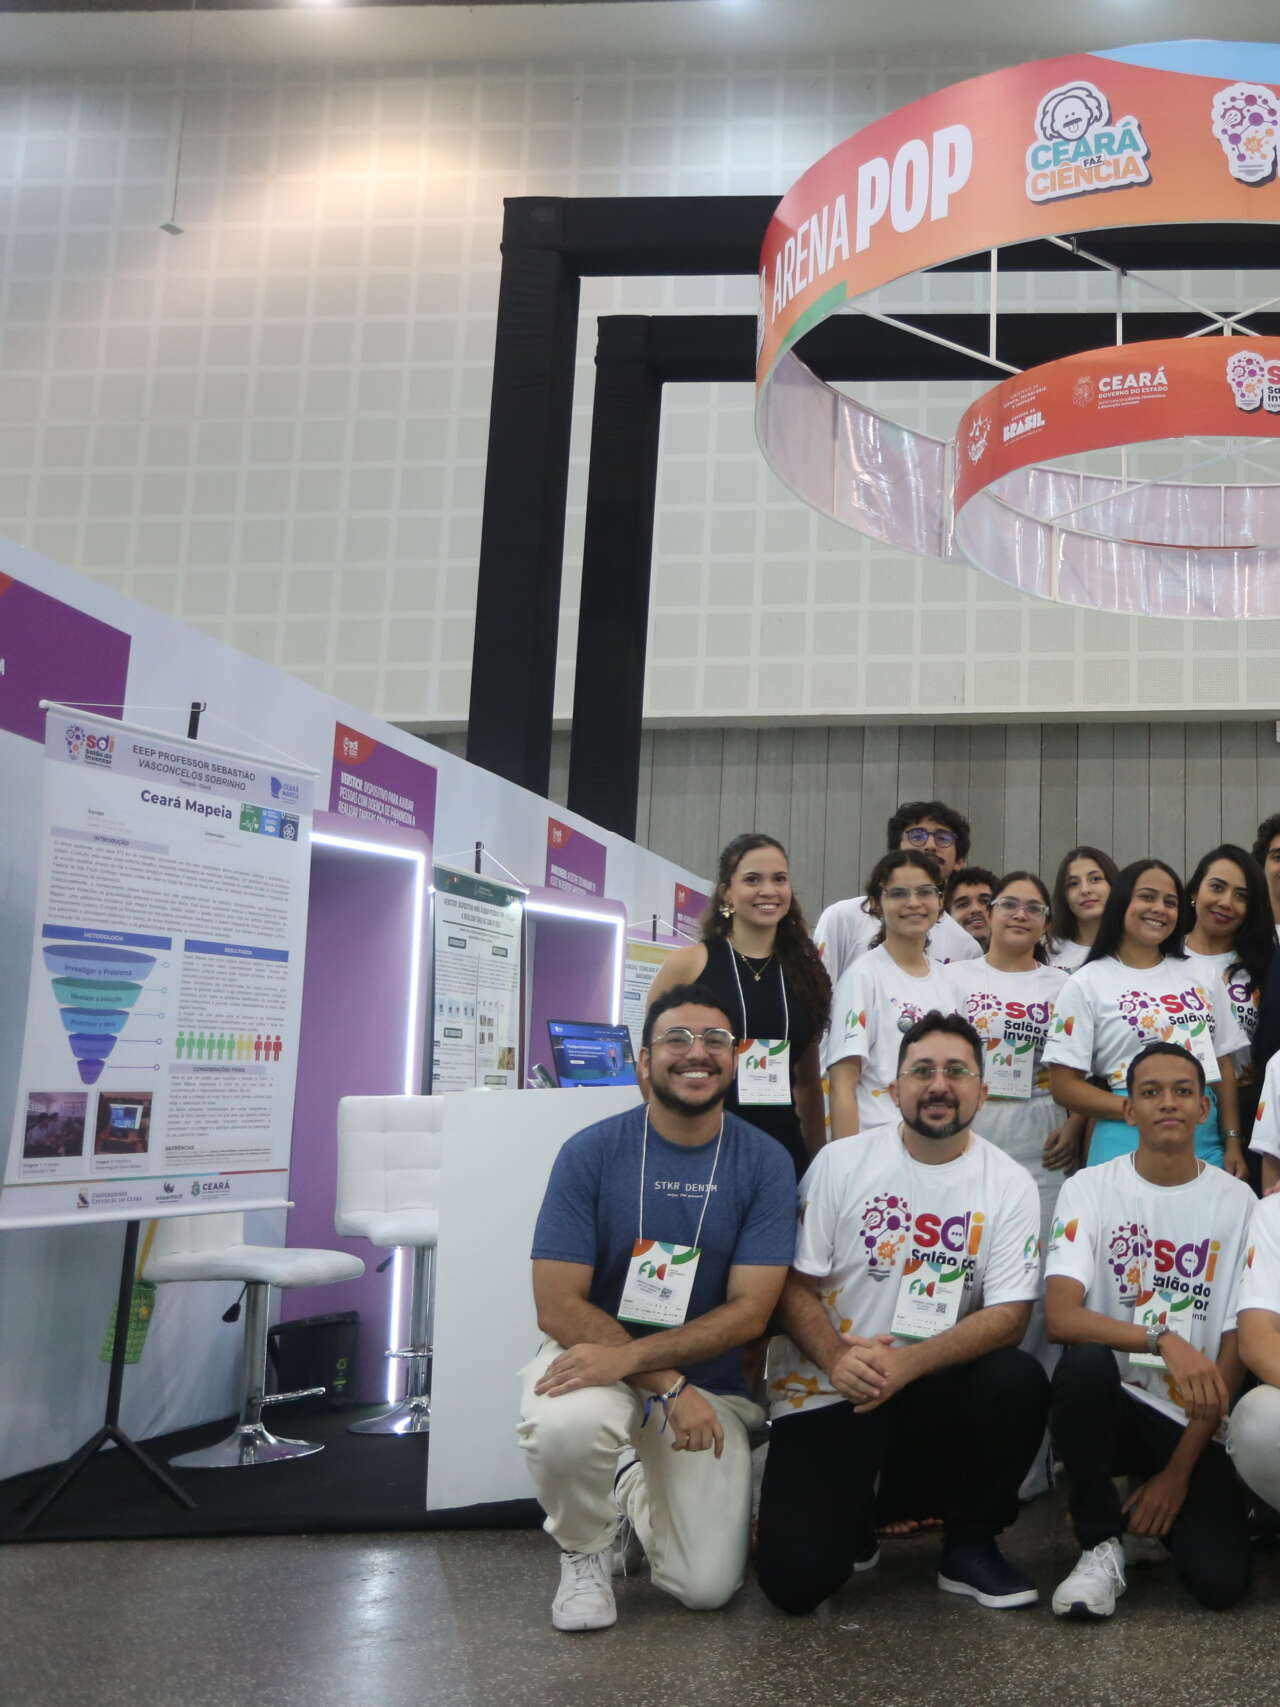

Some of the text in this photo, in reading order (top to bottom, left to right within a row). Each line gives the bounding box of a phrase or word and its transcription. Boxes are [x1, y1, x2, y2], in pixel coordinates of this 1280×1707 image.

[1031, 121, 1142, 171] CEARÁ
[1083, 154, 1105, 168] FAZ
[1031, 158, 1143, 196] CIÊNCIA
[771, 124, 973, 324] ARENA POP
[1099, 366, 1168, 392] CEARÁ
[1003, 411, 1045, 442] BRASIL
[133, 744, 256, 781] EEEP PROFESSOR SEBASTIÃO
[138, 759, 204, 781] VASCONCELOS
[205, 774, 246, 791] SOBRINHO
[141, 789, 232, 820] Ceará Mapeia
[1004, 1019, 1041, 1035] Salão
[202, 1179, 230, 1191] CEARÁ
[655, 1181, 680, 1191] STKR
[913, 1210, 985, 1256] sdi
[1154, 1238, 1221, 1283] sdi
[1193, 1280, 1211, 1297] do
